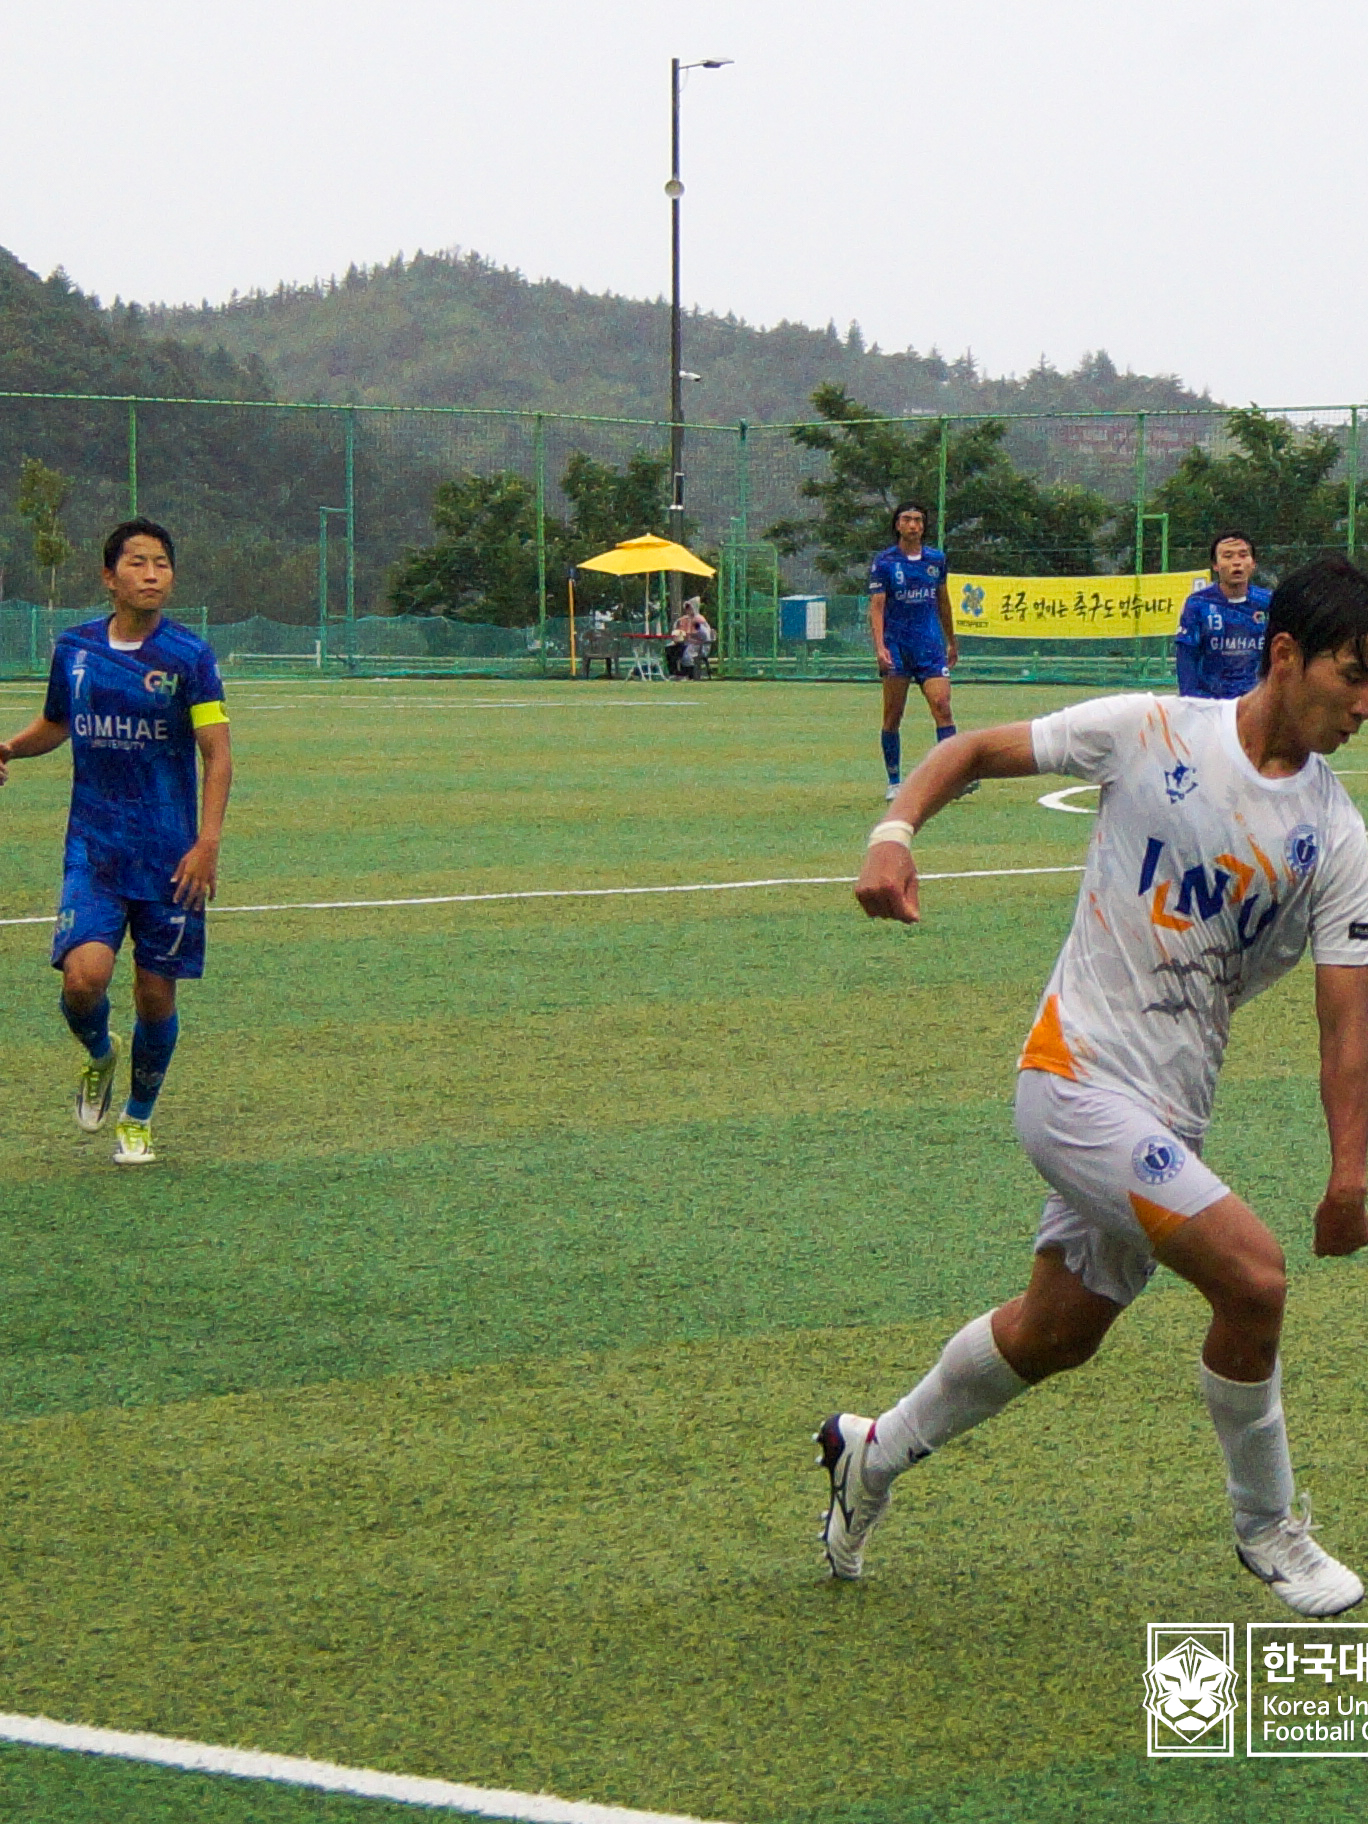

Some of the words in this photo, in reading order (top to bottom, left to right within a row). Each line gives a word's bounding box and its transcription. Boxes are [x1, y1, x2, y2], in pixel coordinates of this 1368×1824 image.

[1000, 591, 1028, 621] 존중
[1034, 597, 1069, 619] 없이는
[1073, 591, 1114, 621] 축구도
[1119, 593, 1174, 619] 없습니다
[1207, 614, 1223, 630] 13
[72, 668, 86, 699] 7
[74, 713, 168, 741] GIMHAE
[168, 916, 186, 956] 7
